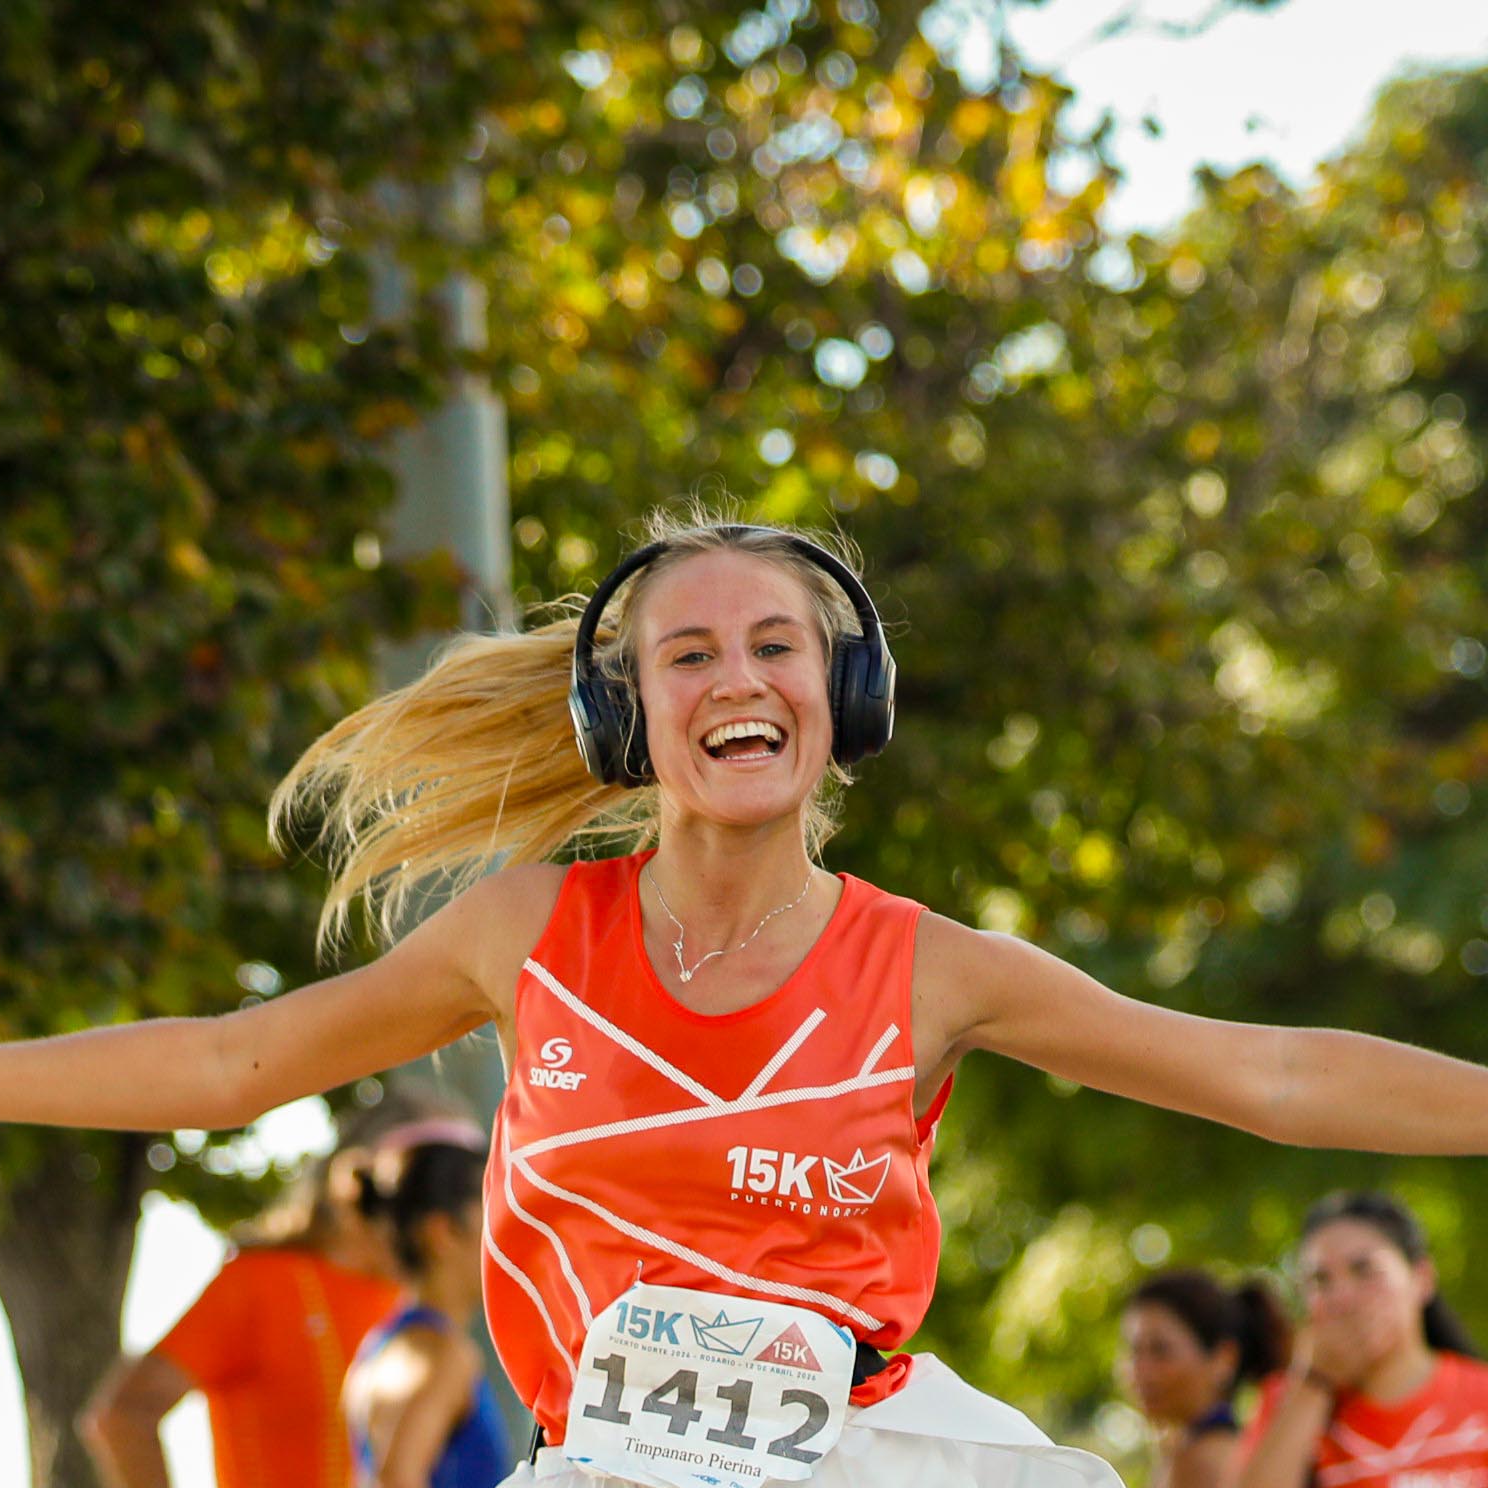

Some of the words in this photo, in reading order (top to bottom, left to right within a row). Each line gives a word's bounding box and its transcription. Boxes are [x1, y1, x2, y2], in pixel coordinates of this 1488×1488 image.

[726, 1145, 819, 1199] 15K
[730, 1192, 812, 1215] PUERTO
[615, 1300, 684, 1345] 15K
[609, 1335, 639, 1350] PUERTO
[641, 1344, 668, 1356] NORTE
[700, 1353, 736, 1367] ROSARIO
[770, 1367, 793, 1377] ABRIL
[772, 1341, 809, 1364] 15K
[582, 1352, 830, 1464] 1412
[625, 1436, 704, 1465] Timpanaro
[708, 1452, 762, 1478] Pierina
